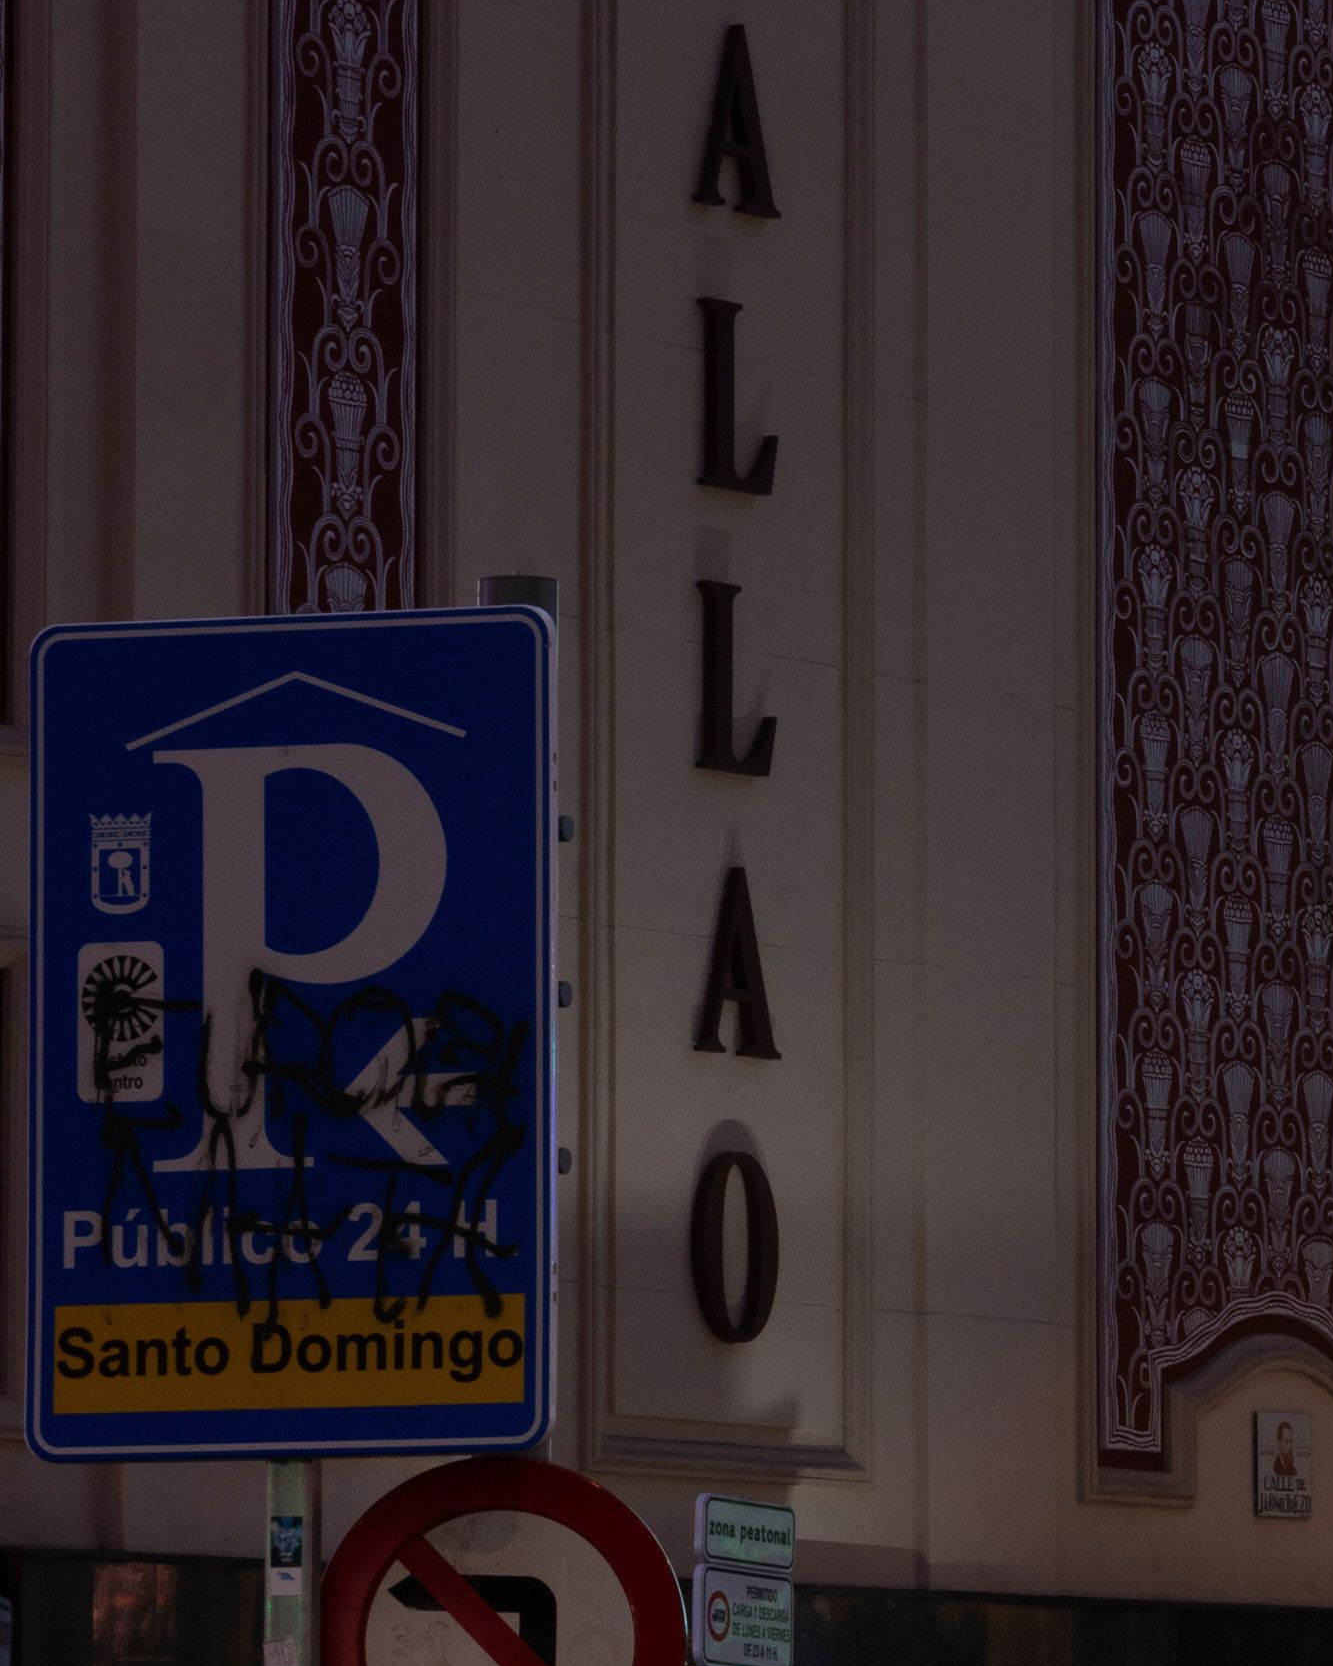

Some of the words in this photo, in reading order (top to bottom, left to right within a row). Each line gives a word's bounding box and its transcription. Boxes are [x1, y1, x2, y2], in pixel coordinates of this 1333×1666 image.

[61, 1205, 324, 1270] Público
[347, 1200, 427, 1262] 24
[57, 1327, 230, 1379] Santo
[250, 1319, 523, 1383] Domingo
[1263, 1475, 1294, 1492] CALLE
[709, 1520, 736, 1538] zona
[740, 1524, 791, 1546] peatonal
[746, 1585, 778, 1603] PERMITIDO
[732, 1602, 753, 1618] CARGA
[758, 1605, 789, 1622] DESCARGA
[732, 1621, 741, 1636] DE
[741, 1623, 761, 1639] LUNES
[743, 1643, 752, 1656] DE
